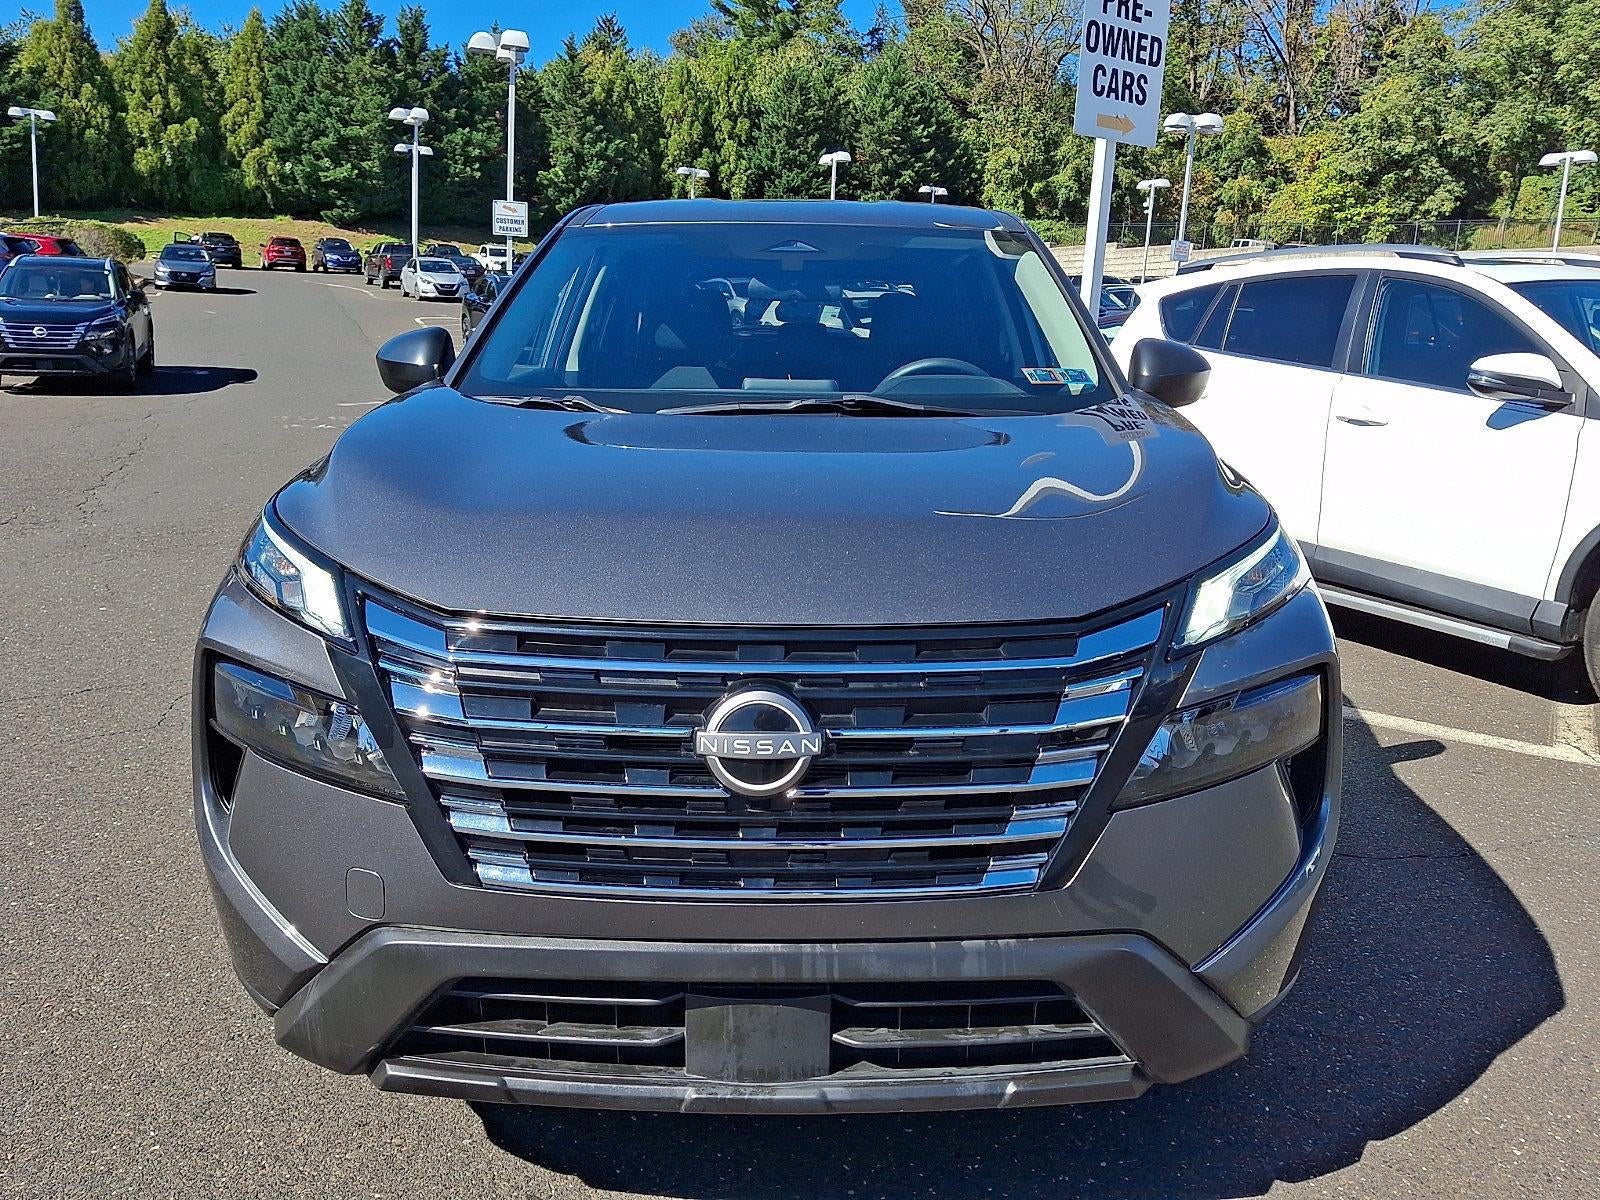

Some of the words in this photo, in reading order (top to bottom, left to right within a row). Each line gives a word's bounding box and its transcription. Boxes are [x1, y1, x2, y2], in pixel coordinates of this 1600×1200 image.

[1085, 19, 1163, 68] OWNED
[1092, 63, 1149, 106] CARS
[495, 217, 525, 226] CUSTOMER
[498, 225, 523, 233] PARKING
[700, 736, 819, 755] NISSAN
